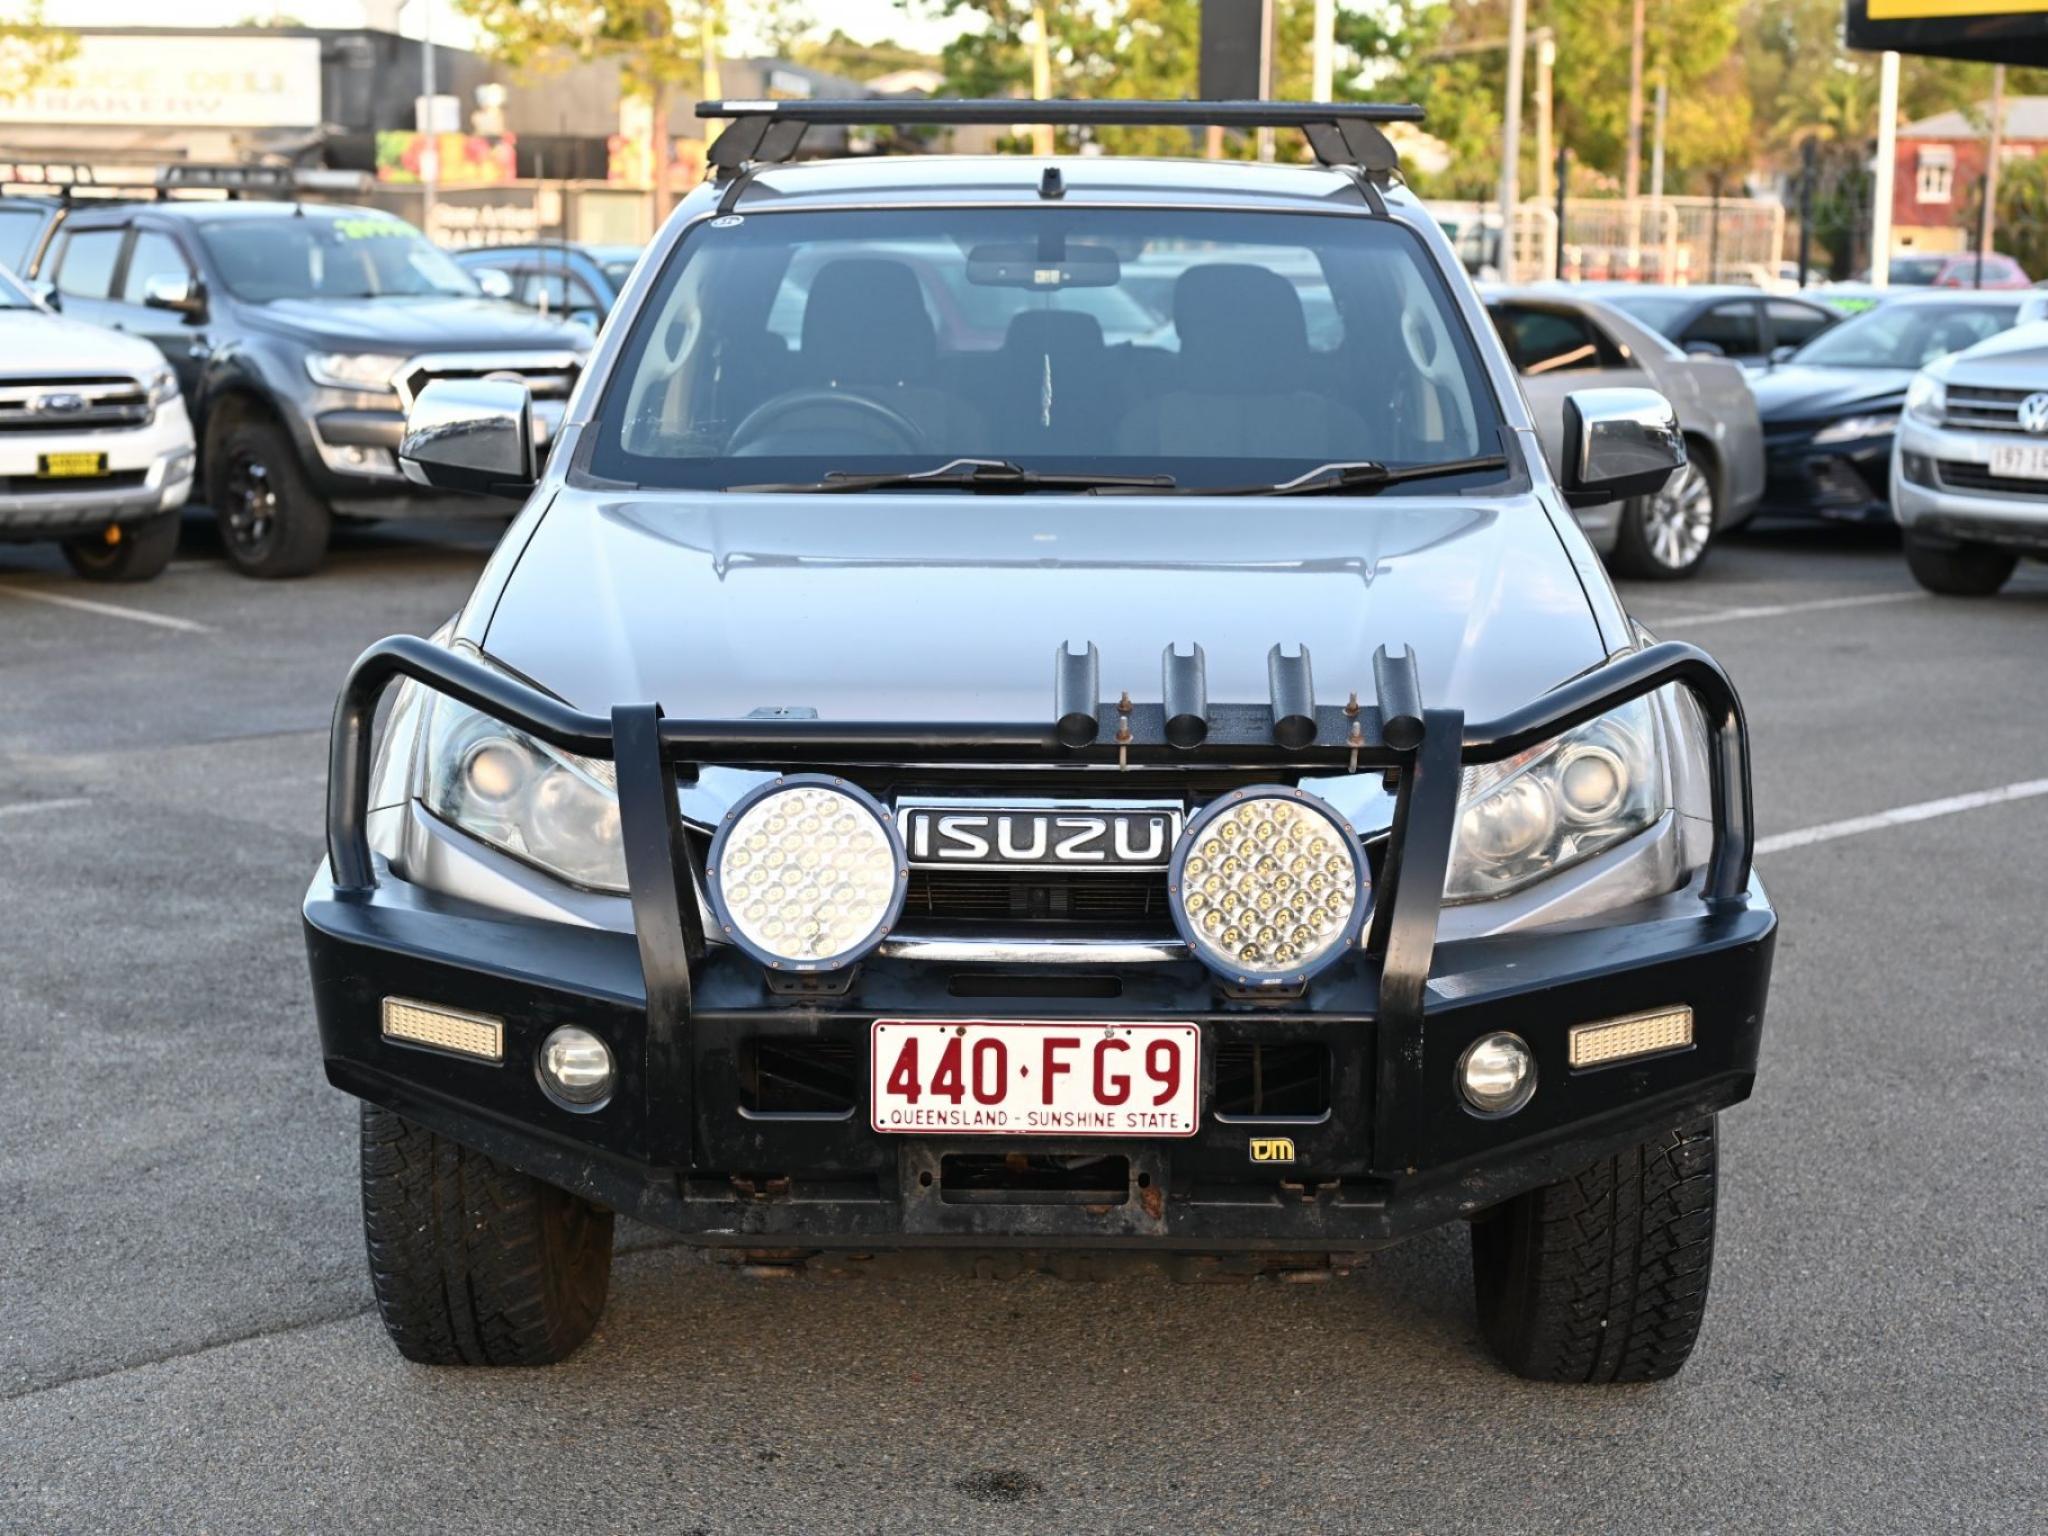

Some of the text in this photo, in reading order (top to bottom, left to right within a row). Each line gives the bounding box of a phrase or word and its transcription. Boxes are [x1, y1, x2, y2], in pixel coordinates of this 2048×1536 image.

[915, 815, 1164, 860] ISUZU
[890, 1109, 1008, 1126] QUEENSLAND
[1027, 1111, 1116, 1128] SUNSHINE
[1127, 1112, 1179, 1129] STATE
